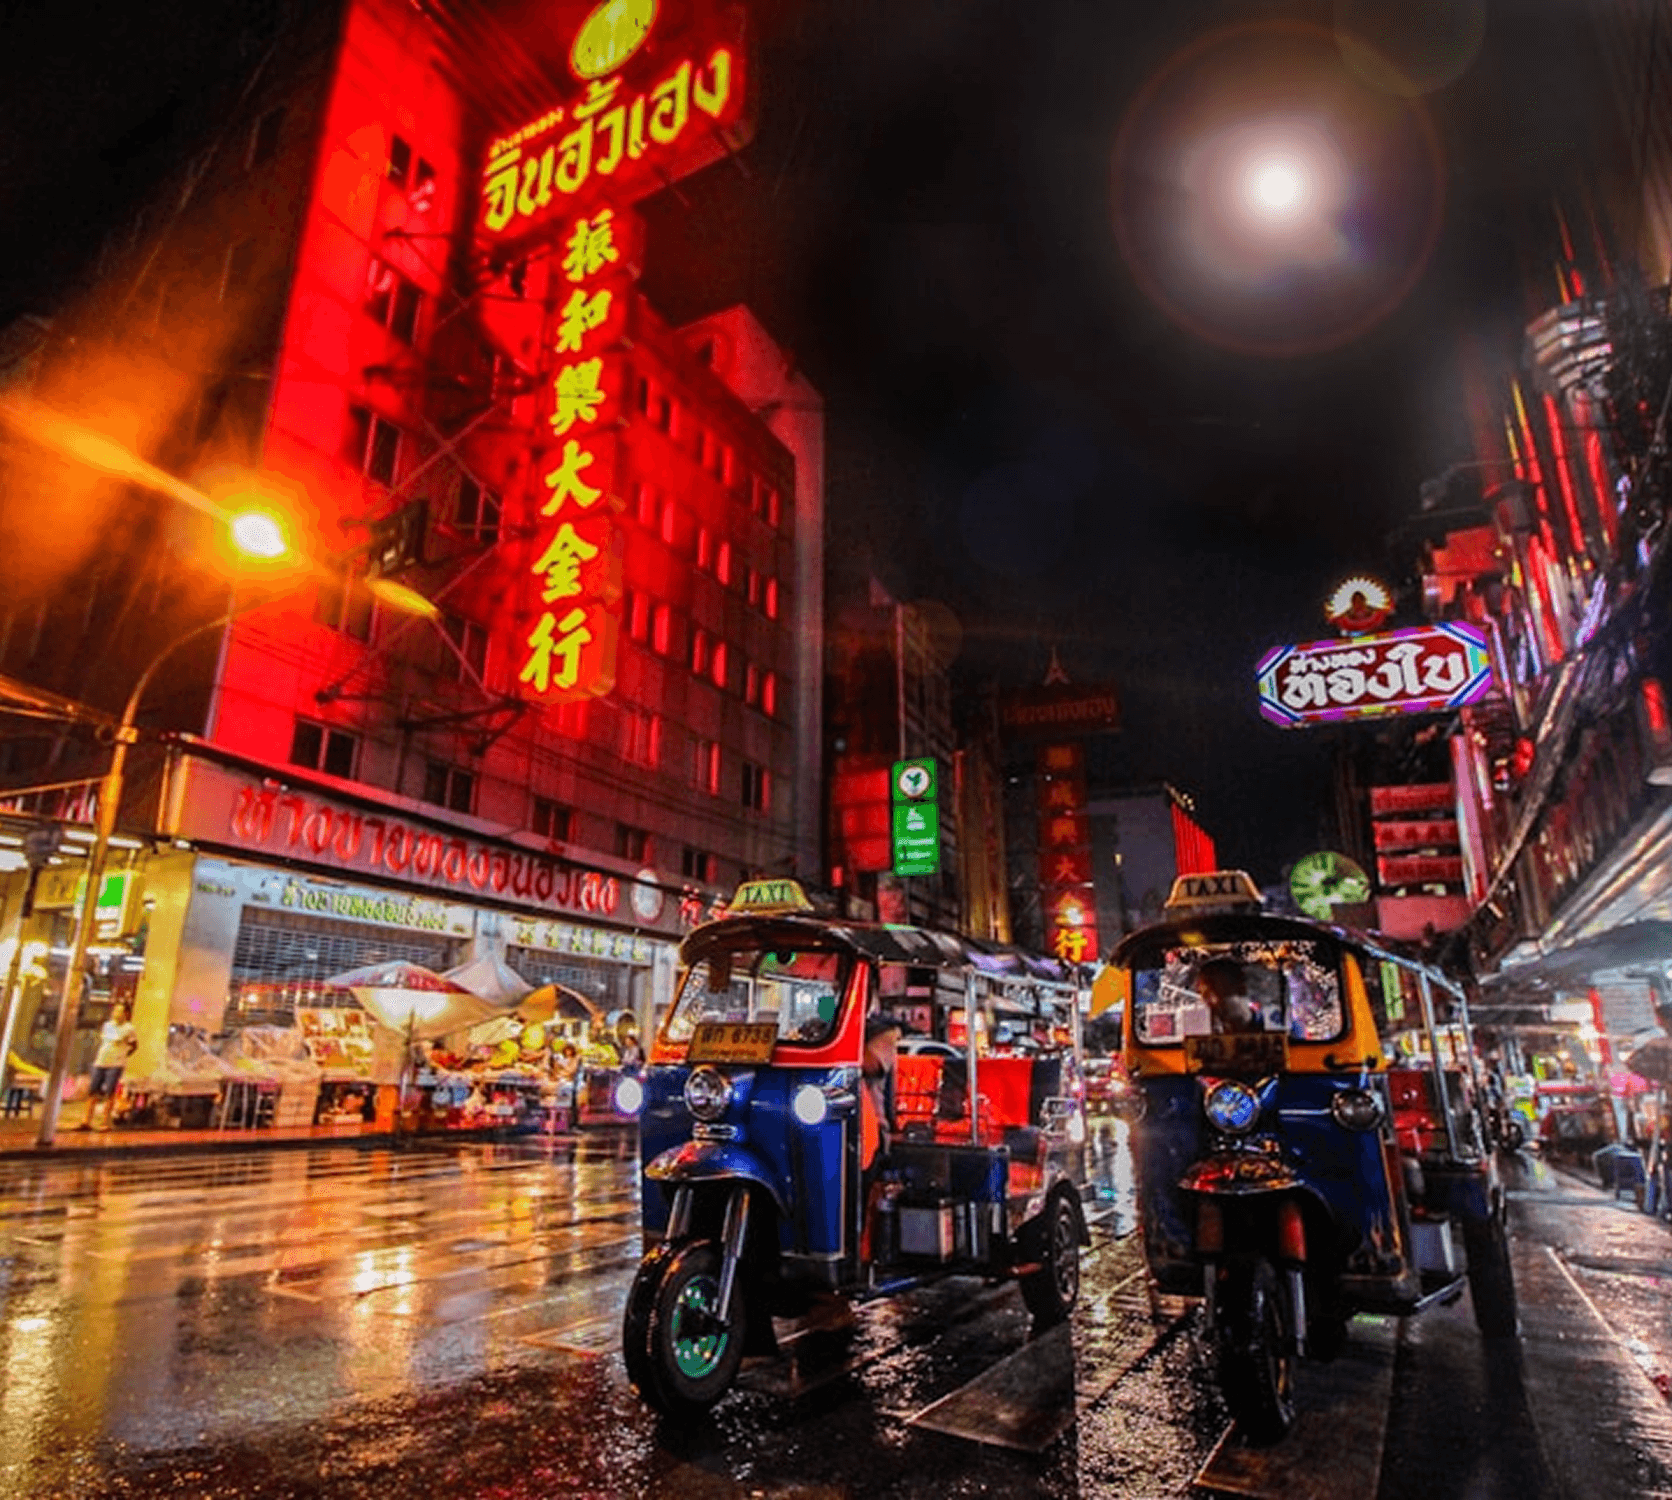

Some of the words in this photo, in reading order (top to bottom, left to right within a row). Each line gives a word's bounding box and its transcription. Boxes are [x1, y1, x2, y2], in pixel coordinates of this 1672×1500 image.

[518, 208, 619, 692] 振和興大金行
[1282, 642, 1463, 708] ทองใบ
[744, 884, 788, 903] TAXI
[1182, 876, 1238, 897] TAXI
